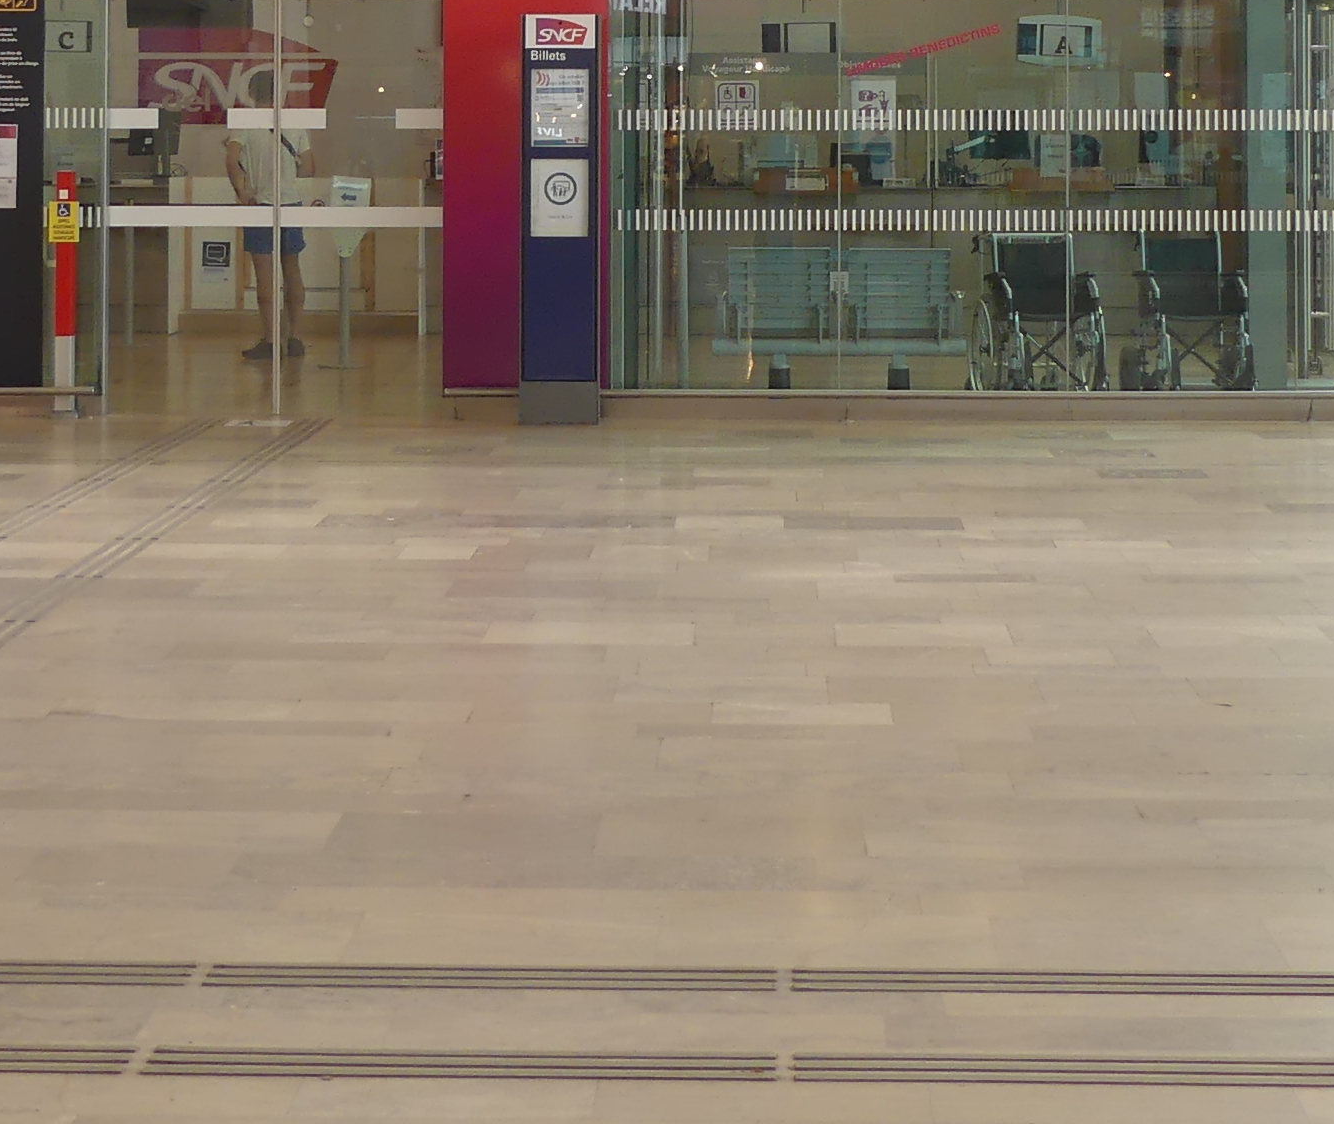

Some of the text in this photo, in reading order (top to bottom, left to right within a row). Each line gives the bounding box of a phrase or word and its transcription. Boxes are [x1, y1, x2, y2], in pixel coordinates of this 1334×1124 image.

[58, 31, 75, 50] C
[538, 27, 586, 43] SNCF
[1054, 36, 1073, 55] A
[530, 50, 567, 62] Billets
[153, 61, 326, 111] SNCF
